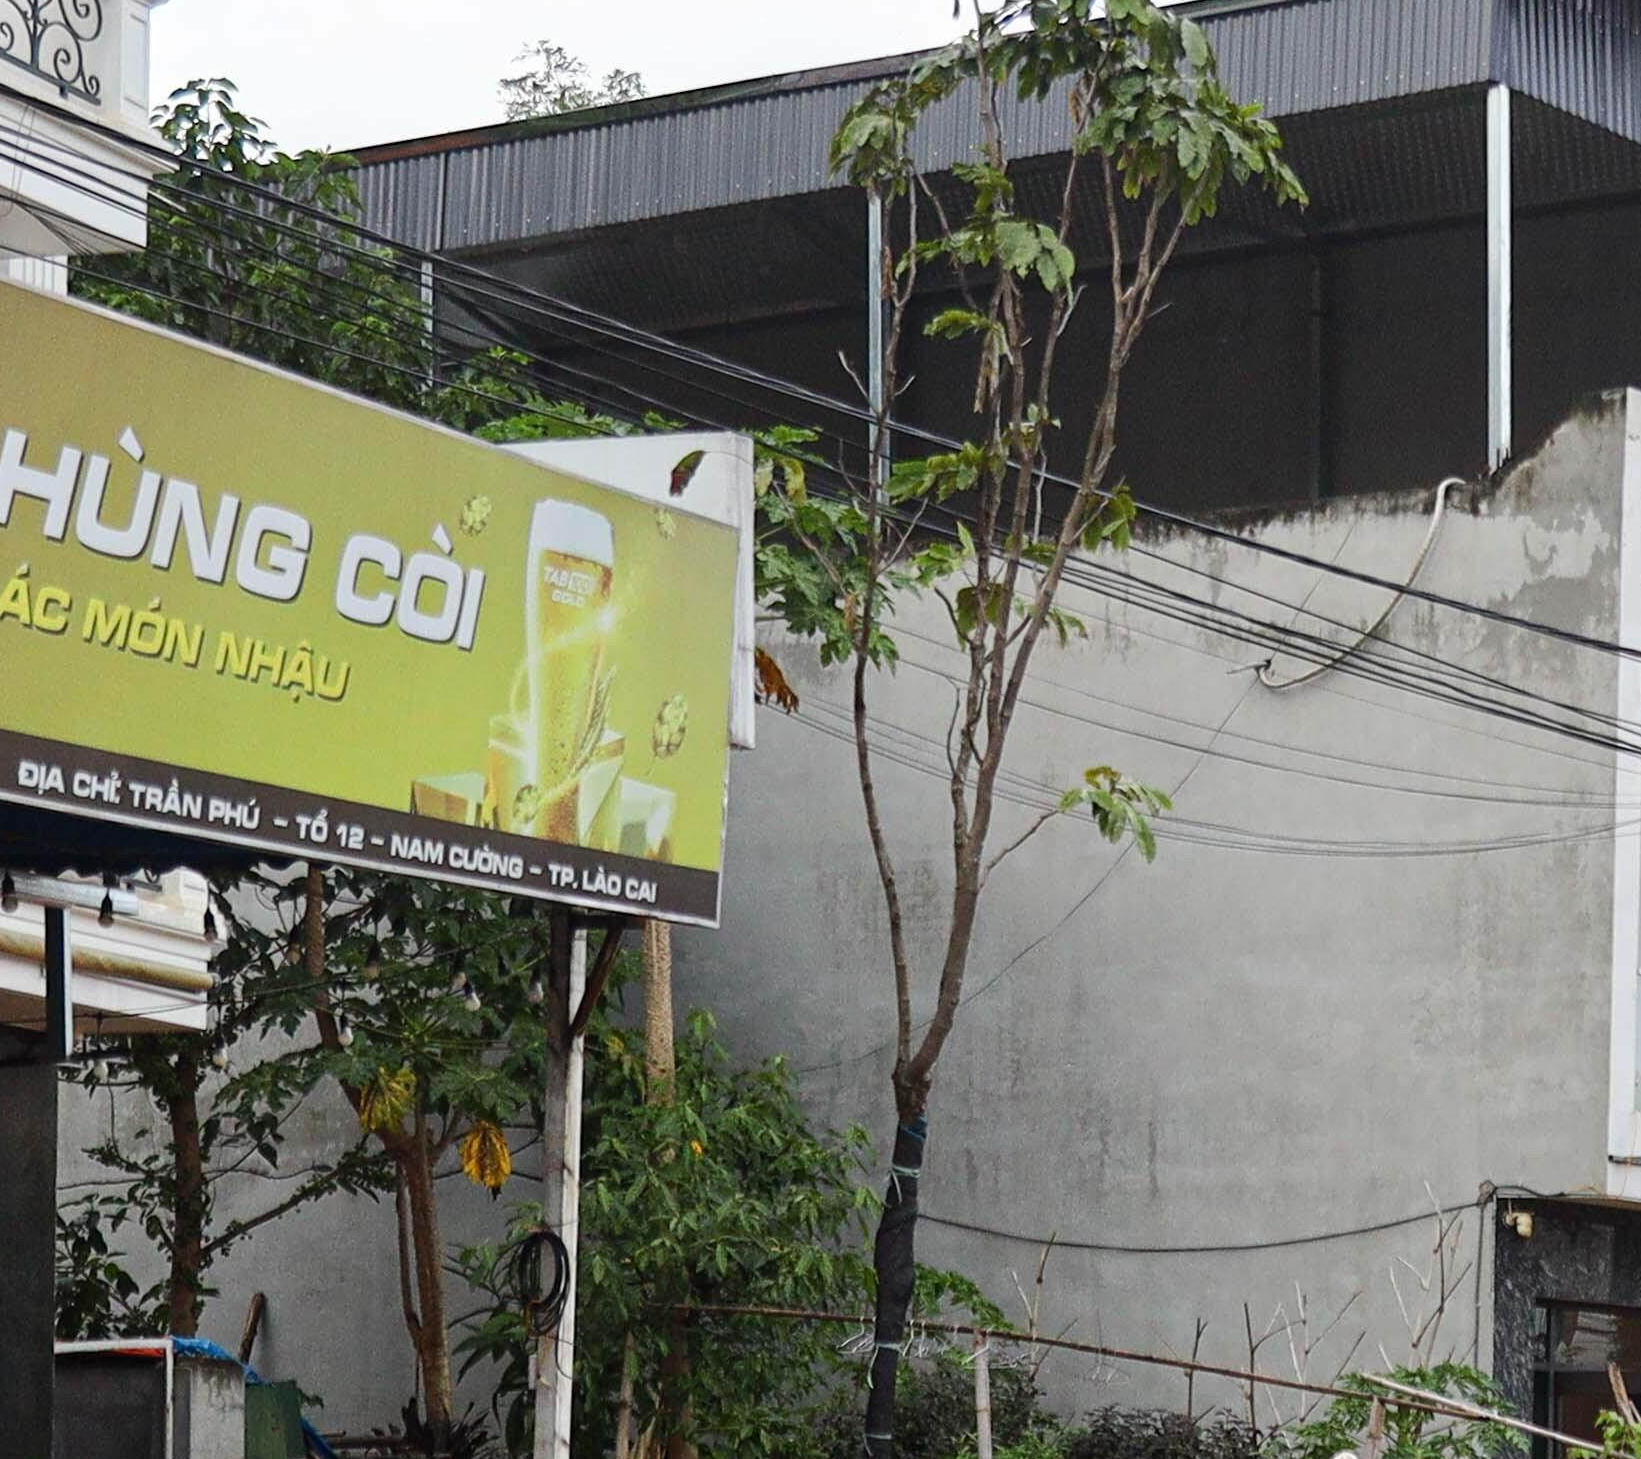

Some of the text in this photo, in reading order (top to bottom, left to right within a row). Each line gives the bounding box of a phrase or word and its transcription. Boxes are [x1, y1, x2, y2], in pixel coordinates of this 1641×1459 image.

[81, 597, 205, 669] MÓN
[214, 639, 351, 703] NHẬU
[335, 522, 486, 651] CÒI
[17, 760, 65, 796] ĐỊA
[129, 777, 203, 820] TRẦN
[208, 797, 261, 830] PHÚ
[296, 808, 329, 843] TỔ
[335, 824, 365, 851] 12
[390, 833, 445, 866] NAM
[448, 841, 524, 880] CƯỜNG
[582, 865, 622, 898] LÀO
[624, 879, 659, 904] CAI
